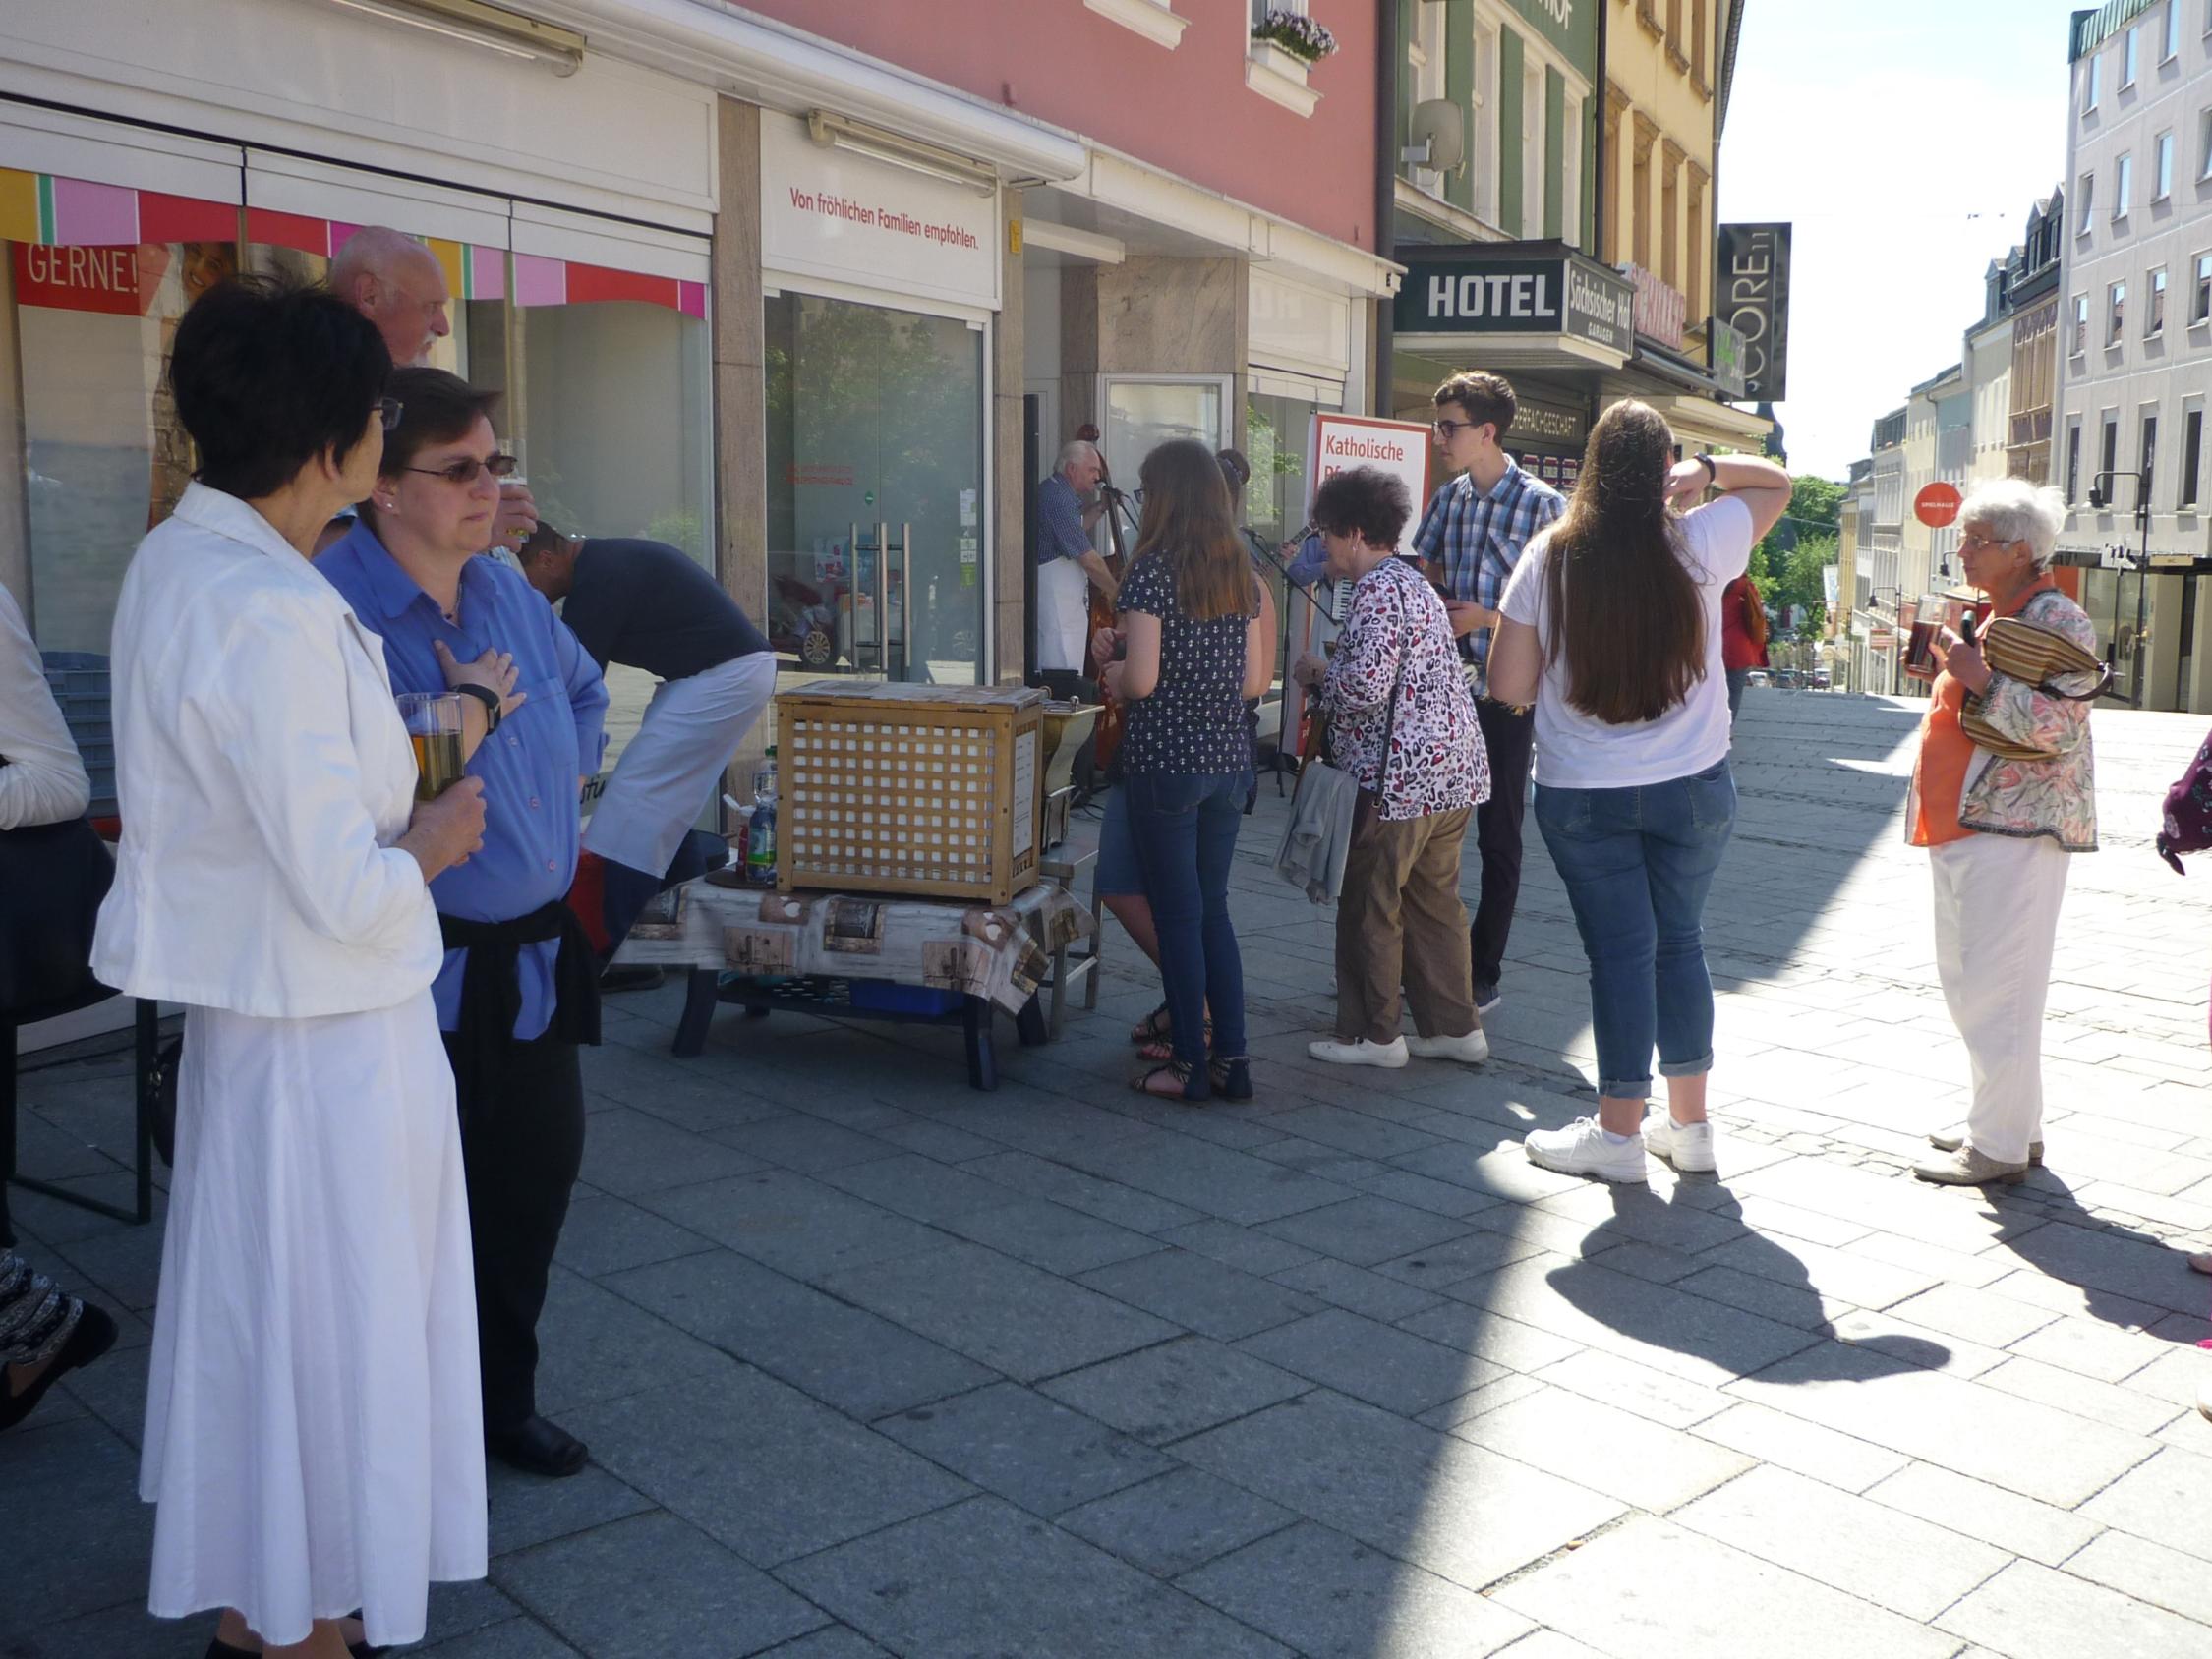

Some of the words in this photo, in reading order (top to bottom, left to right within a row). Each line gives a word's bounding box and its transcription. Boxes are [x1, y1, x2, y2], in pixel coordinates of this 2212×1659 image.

[790, 187, 814, 211] Von
[817, 193, 875, 225] fröhlichen
[878, 208, 922, 237] Familien
[924, 223, 980, 250] empfohlen.
[28, 243, 139, 294] GERNE!
[1428, 274, 1555, 317] HOTEL
[1570, 269, 1615, 325] Sächsischer
[1588, 321, 1613, 344] GARAGEN
[1325, 434, 1404, 462] Katholische
